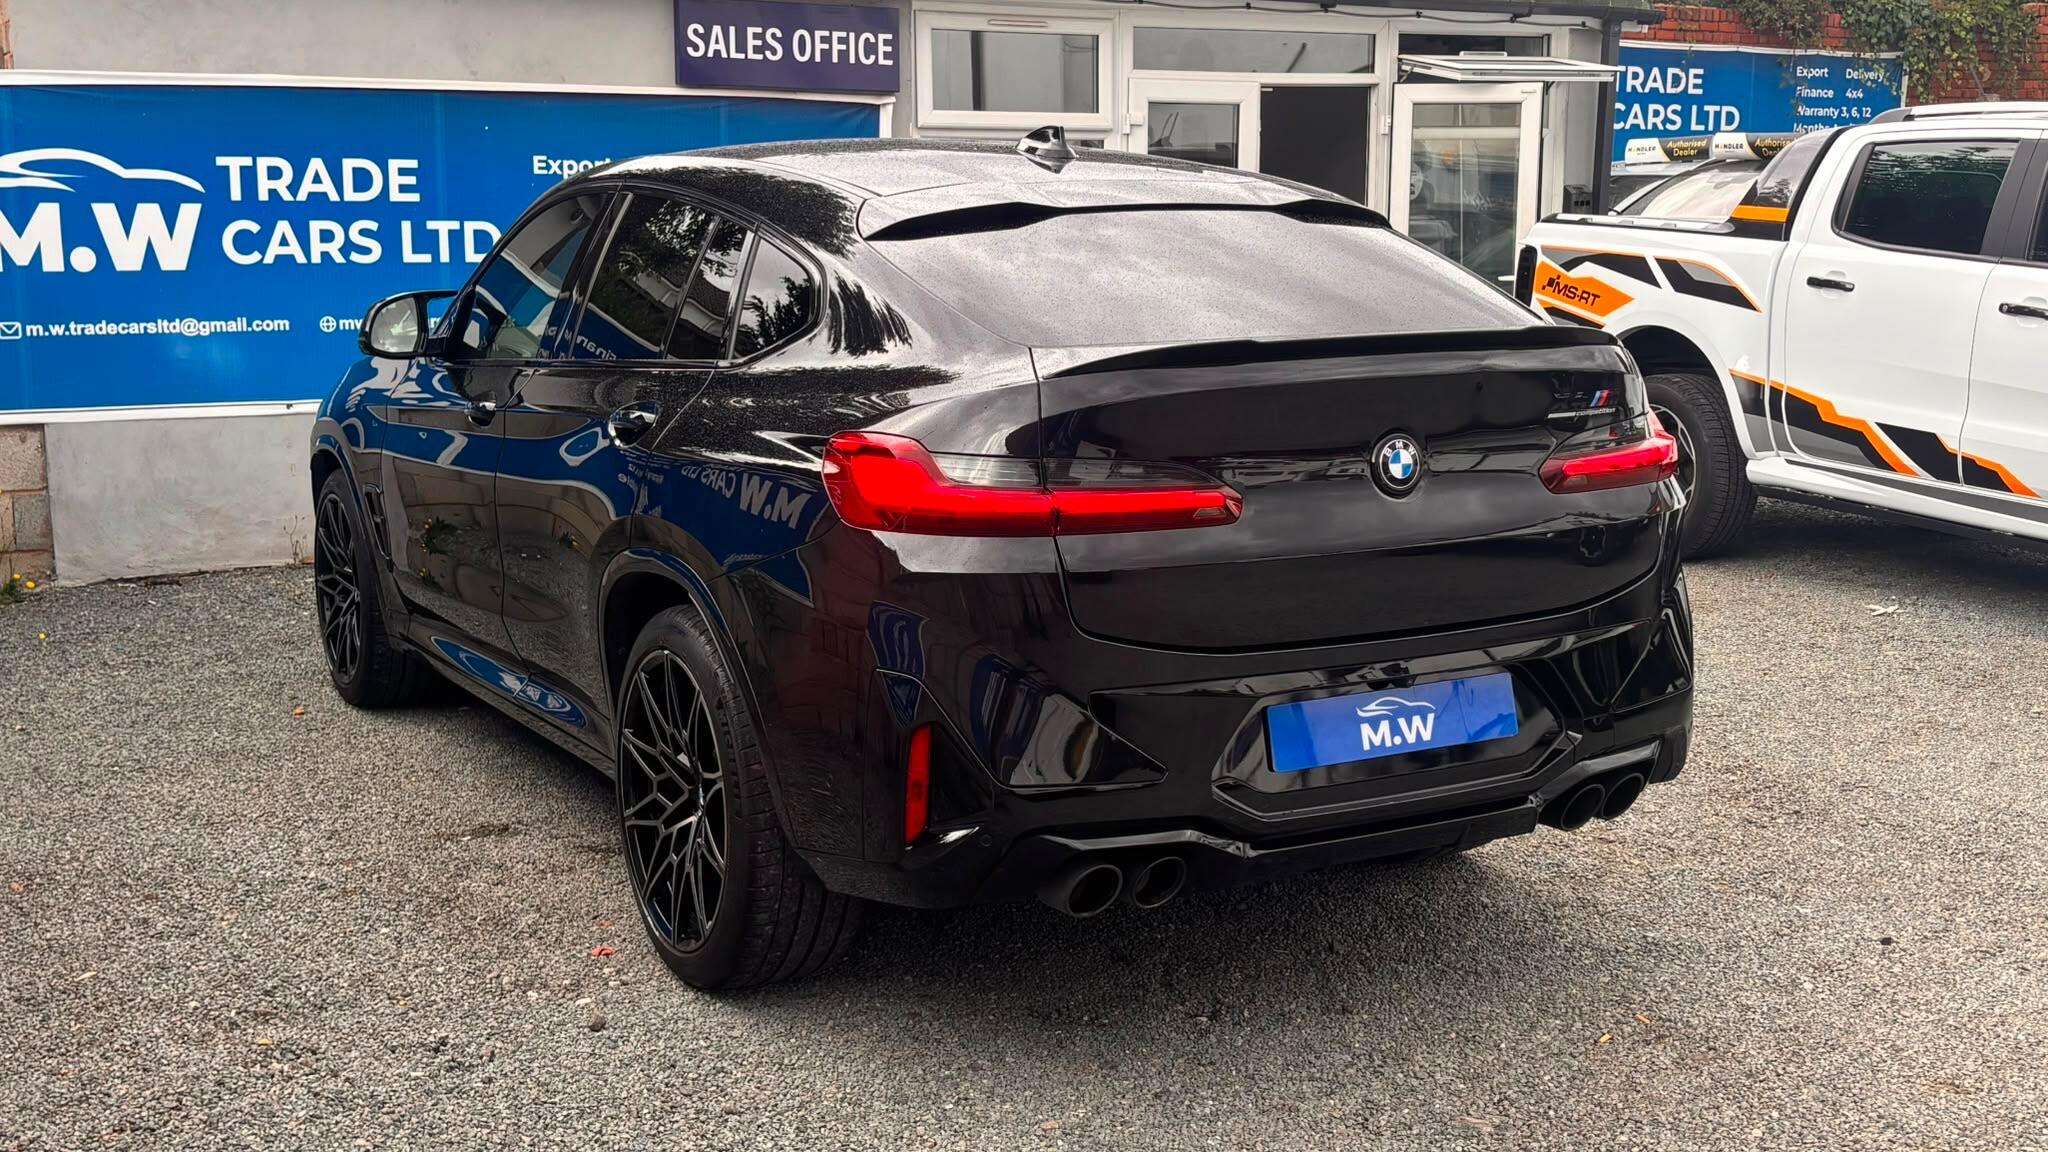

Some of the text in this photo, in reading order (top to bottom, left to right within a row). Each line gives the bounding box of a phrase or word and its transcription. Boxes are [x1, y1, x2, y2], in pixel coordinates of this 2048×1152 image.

[686, 23, 894, 66] SALES OFFICE
[1796, 66, 1829, 79] Export
[1845, 88, 1864, 99] 4x4
[1690, 104, 1741, 132] LTD
[1840, 106, 1850, 118] 3,
[1851, 106, 1860, 118] 6,
[1862, 107, 1872, 117] 12
[1673, 148, 1698, 156] Dealer
[215, 156, 421, 202] TRADE
[221, 219, 503, 265] CARS LTD
[25, 317, 290, 336] m.w.tradecarsltd@gmail.com
[1384, 441, 1417, 457] BMW
[1360, 712, 1435, 751] M.W
